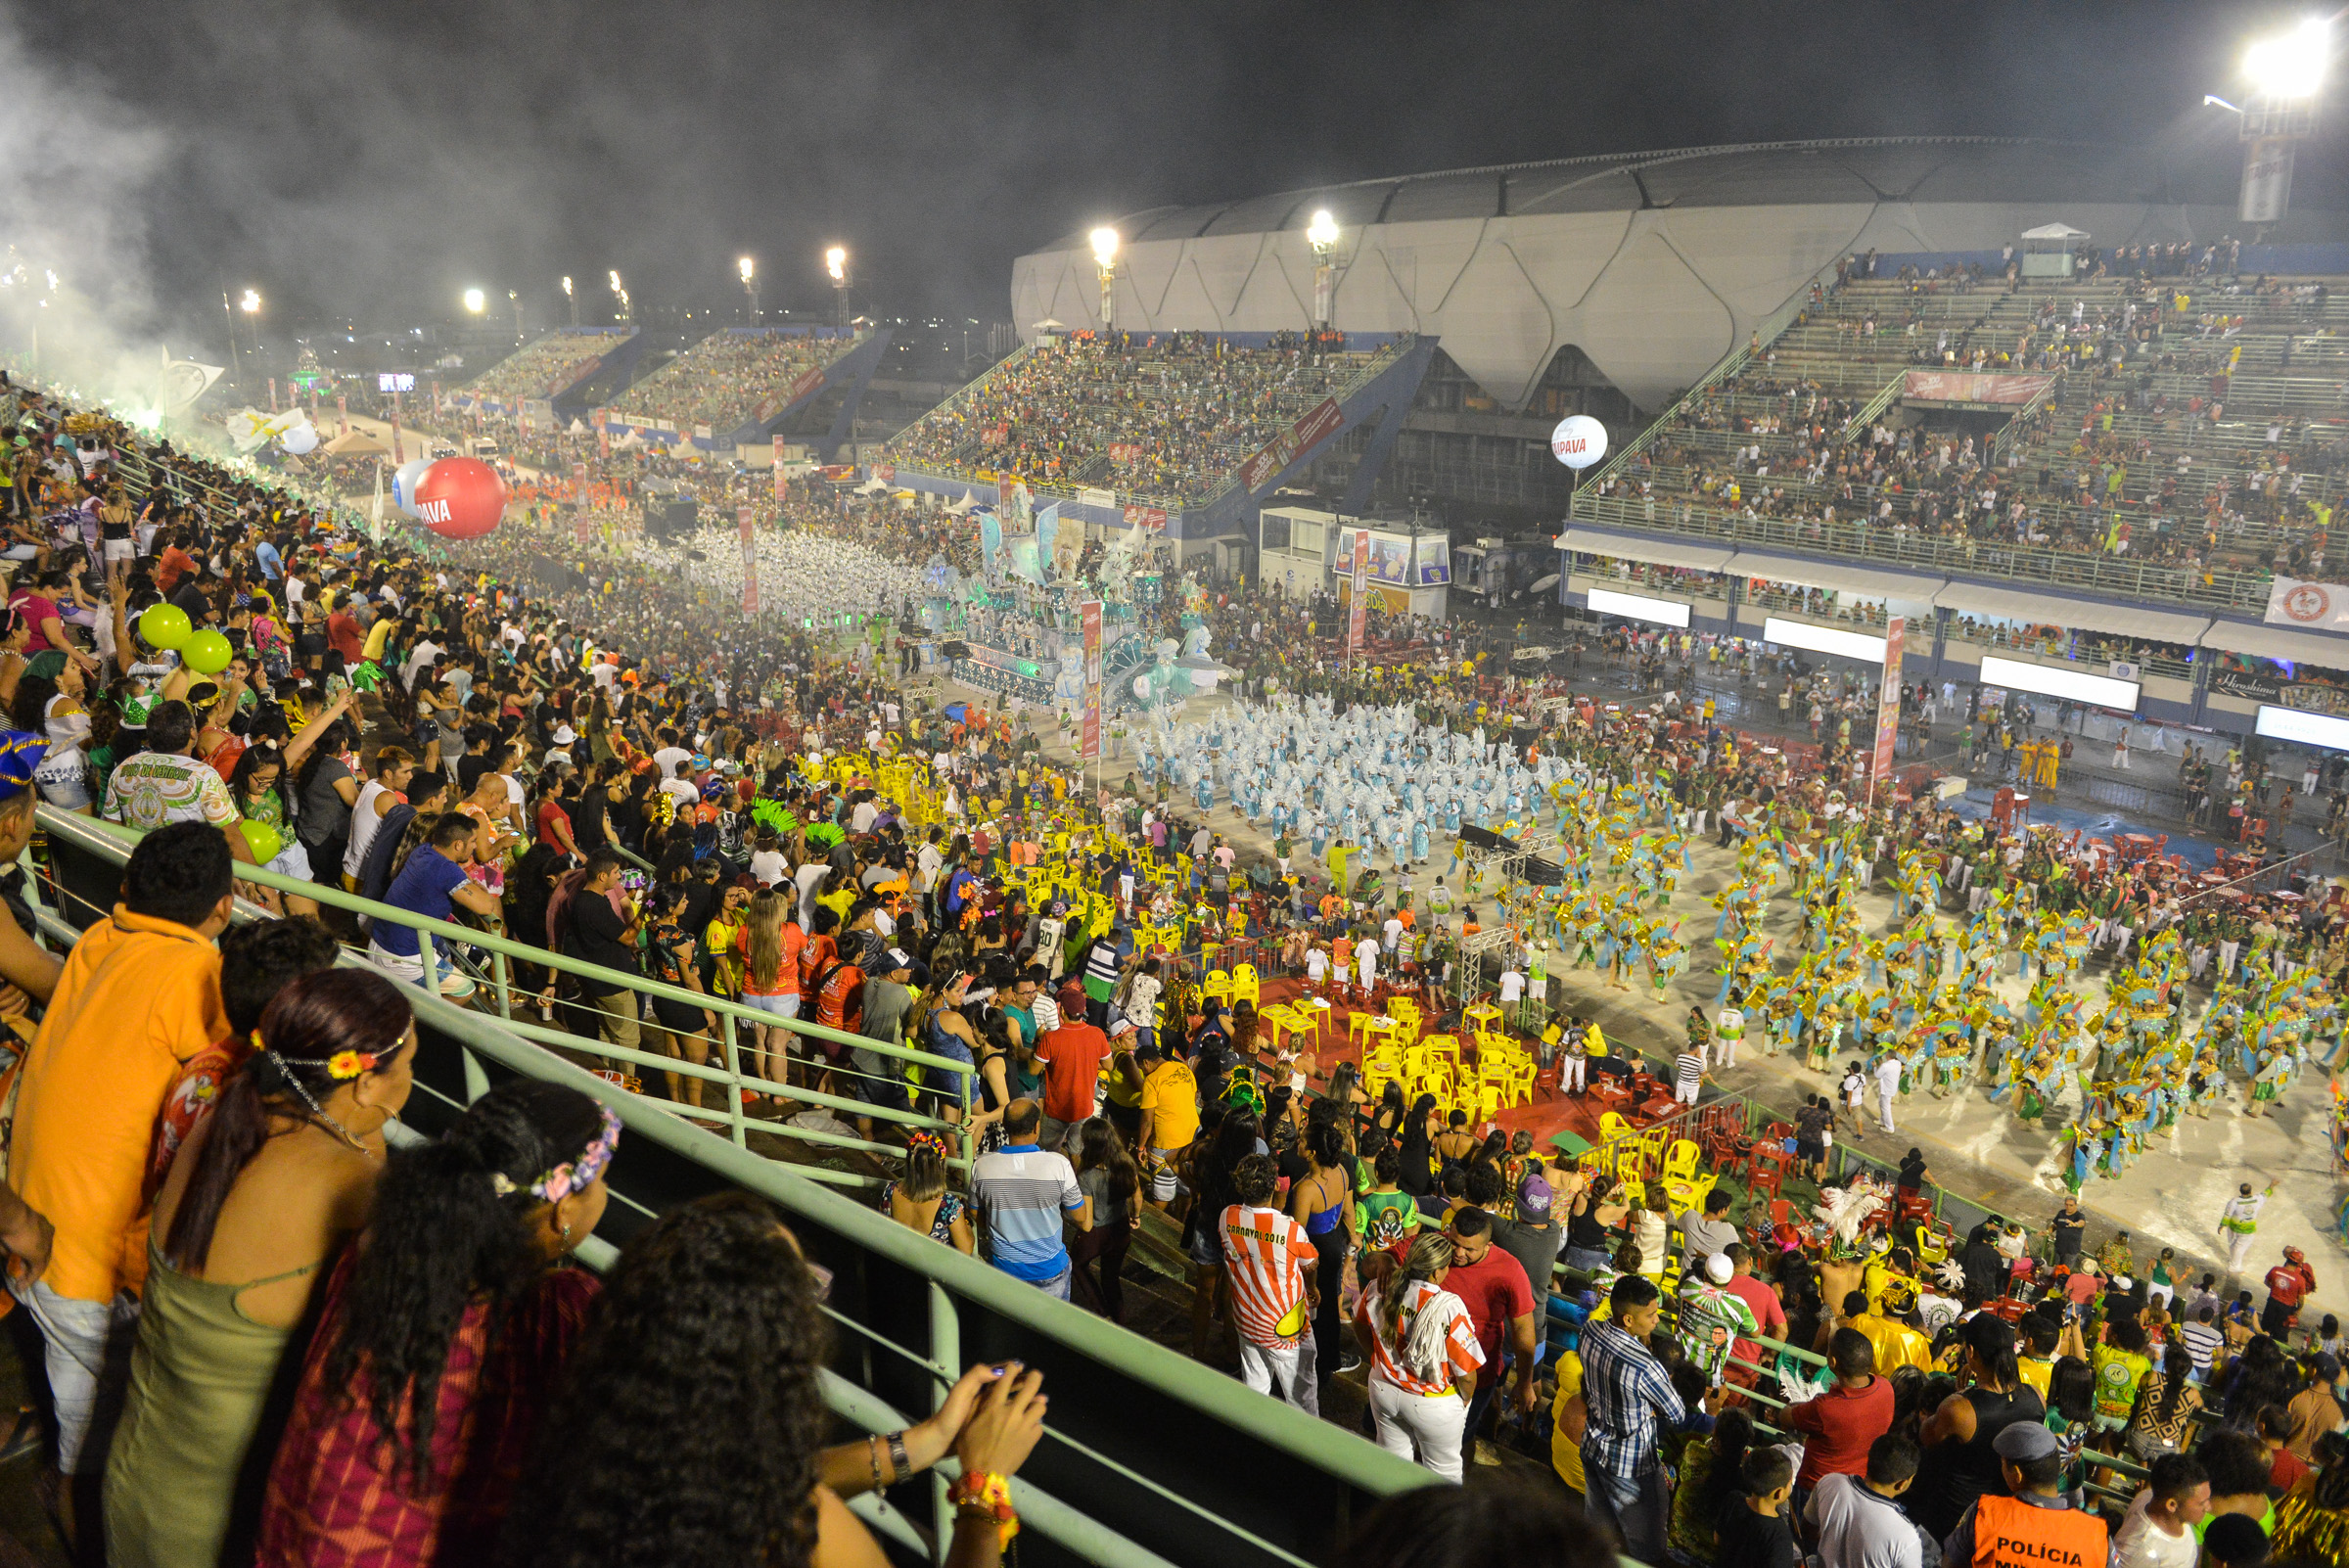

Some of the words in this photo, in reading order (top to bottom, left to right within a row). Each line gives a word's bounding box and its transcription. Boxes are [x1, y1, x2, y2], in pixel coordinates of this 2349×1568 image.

[2220, 673, 2278, 695] Hiroshima
[153, 765, 193, 781] DESTAQUE
[1226, 1223, 1263, 1240] CARNAVAL
[1265, 1232, 1286, 1245] 2018
[1997, 1537, 2082, 1567] POLÍCIA
